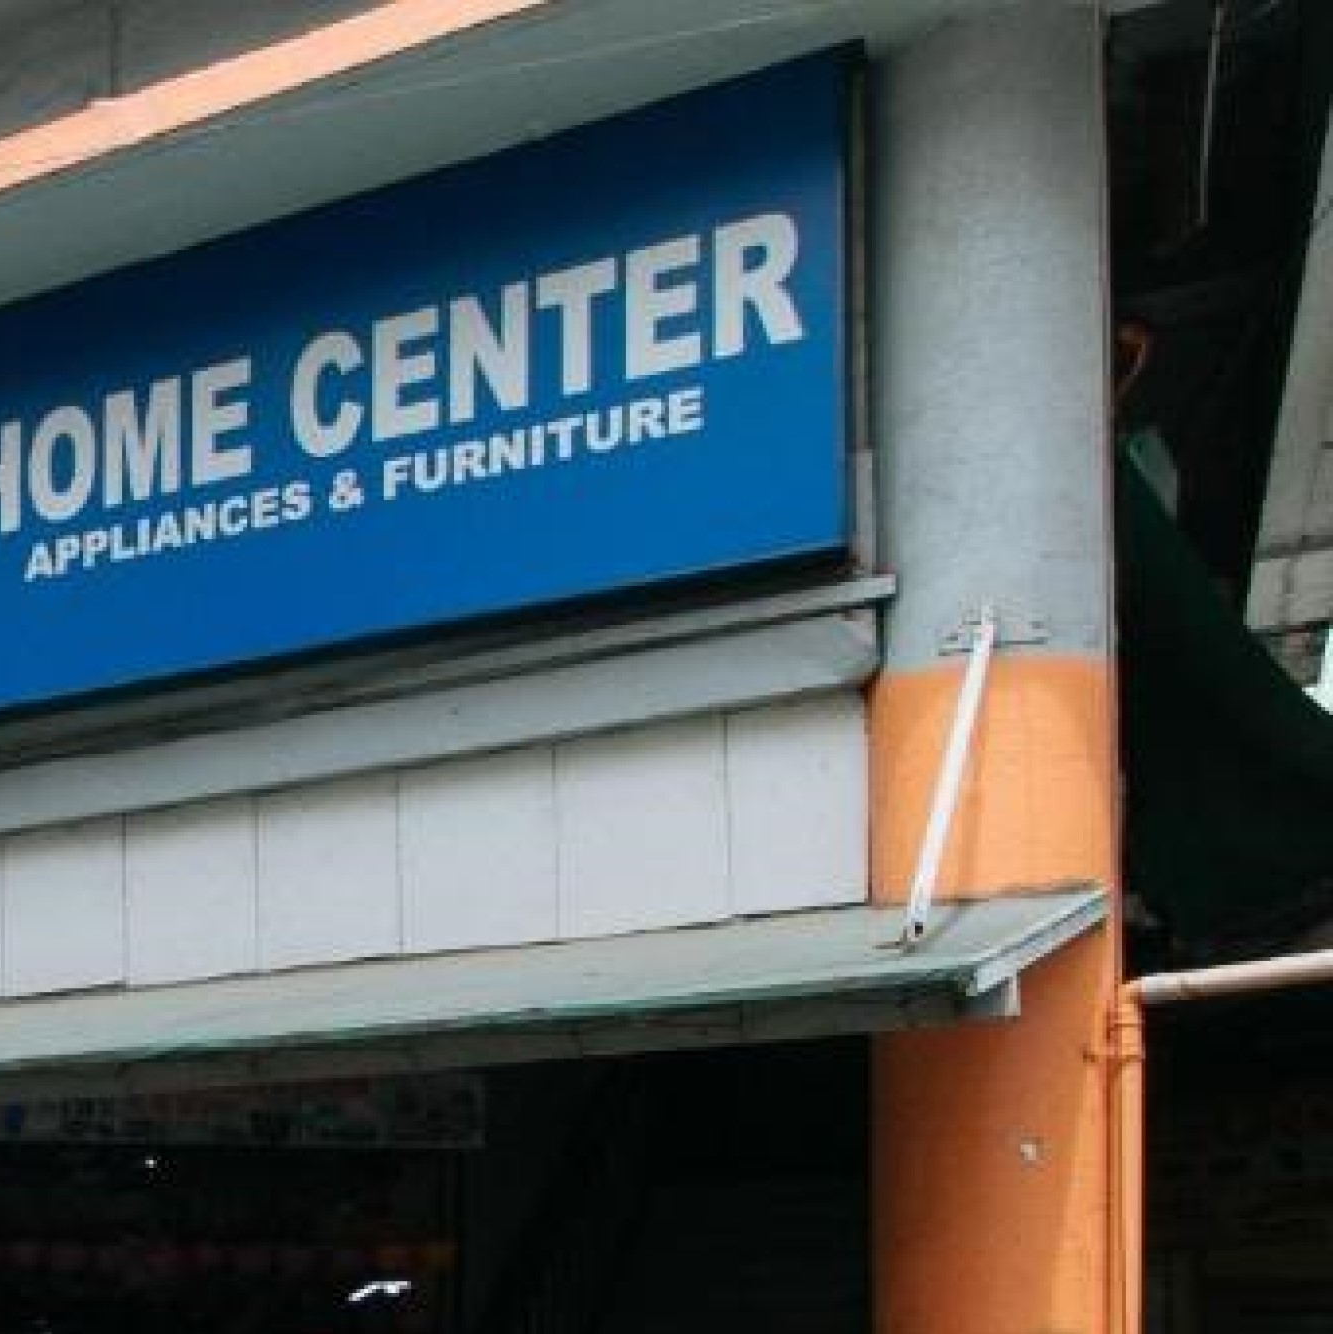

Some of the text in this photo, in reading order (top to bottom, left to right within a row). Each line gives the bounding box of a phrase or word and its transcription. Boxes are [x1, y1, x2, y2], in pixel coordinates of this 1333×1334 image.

[289, 212, 804, 458] CENTER
[24, 387, 704, 583] APPLIANCES & FURNITURE
